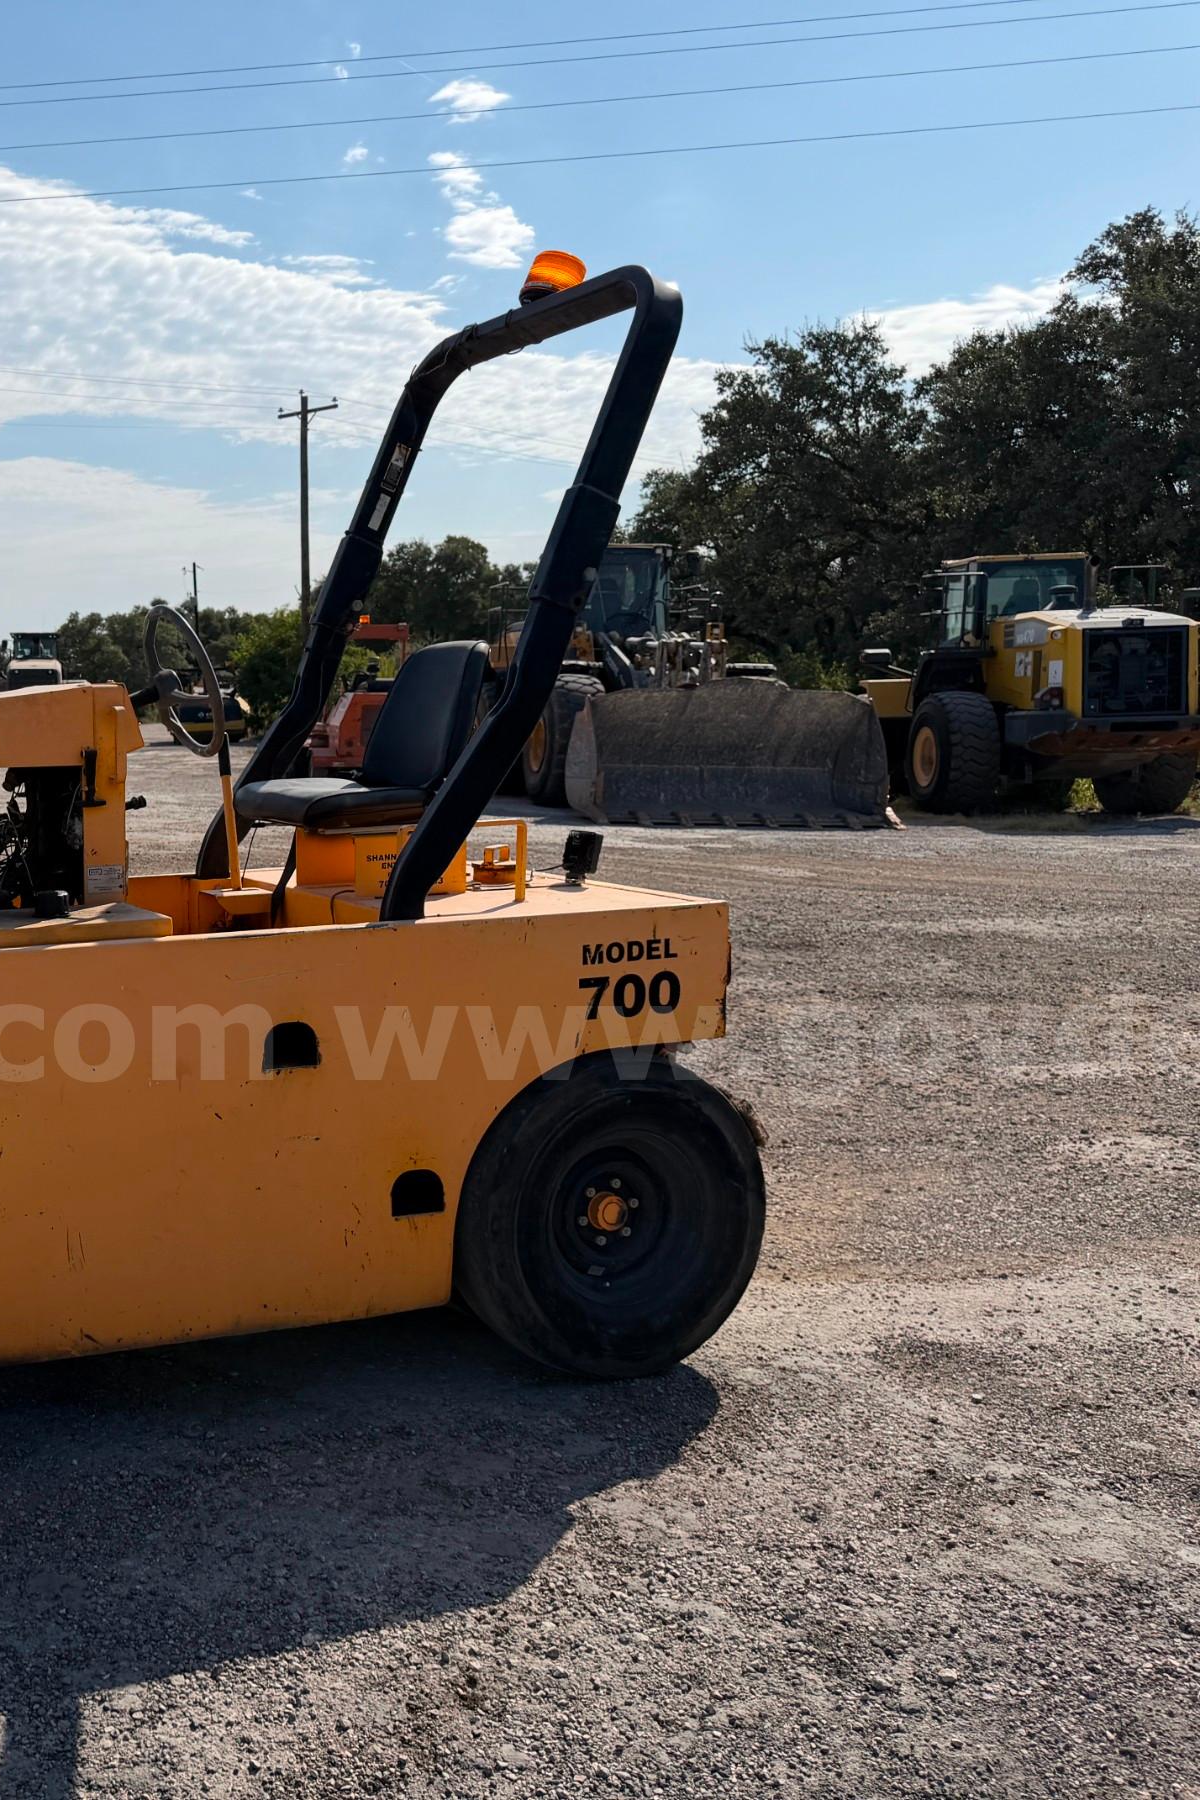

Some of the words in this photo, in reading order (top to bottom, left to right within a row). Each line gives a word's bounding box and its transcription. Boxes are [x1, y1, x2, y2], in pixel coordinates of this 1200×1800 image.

[366, 853, 400, 862] SHANN
[582, 938, 677, 965] MODEL
[578, 971, 681, 1020] 700
